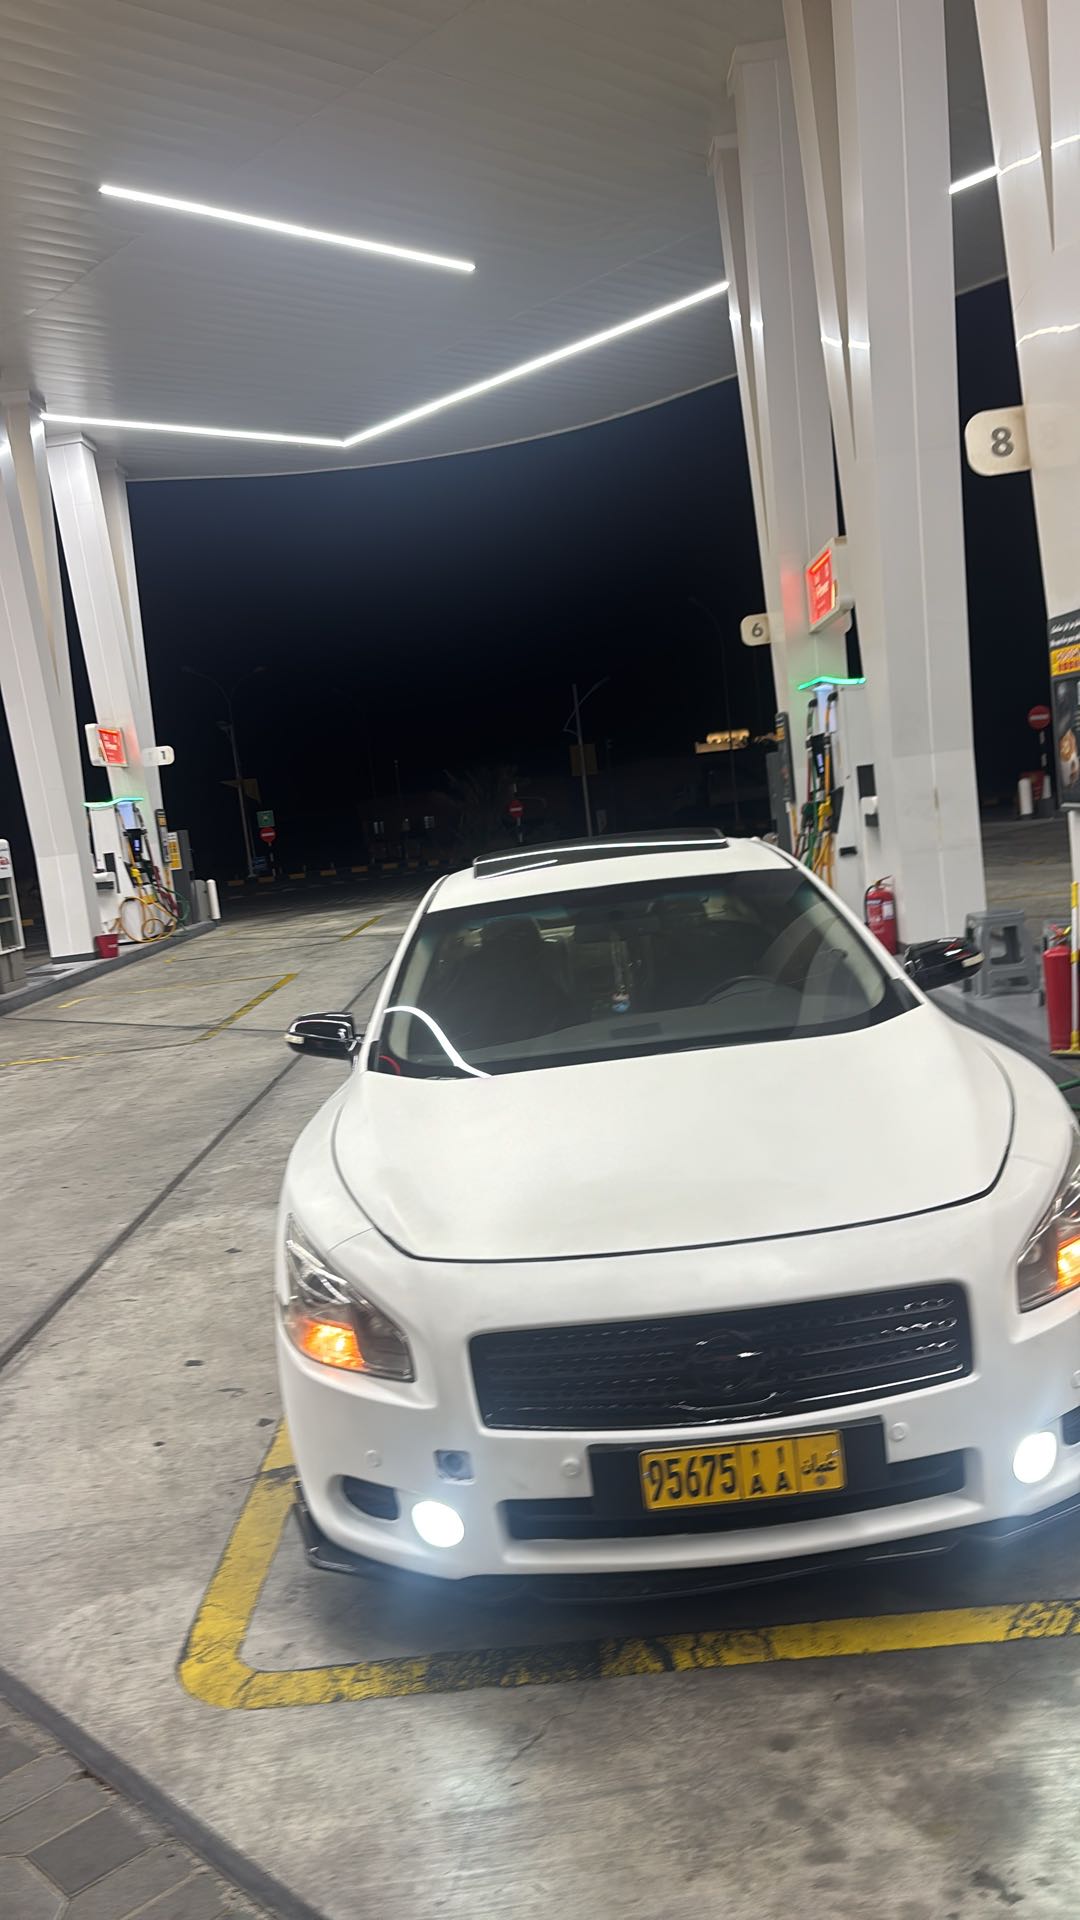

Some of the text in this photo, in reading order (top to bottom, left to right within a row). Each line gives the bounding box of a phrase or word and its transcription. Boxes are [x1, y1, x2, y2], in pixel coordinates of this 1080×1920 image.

[991, 426, 1014, 458] 8
[752, 622, 764, 637] 6
[649, 1453, 737, 1500] 95675
